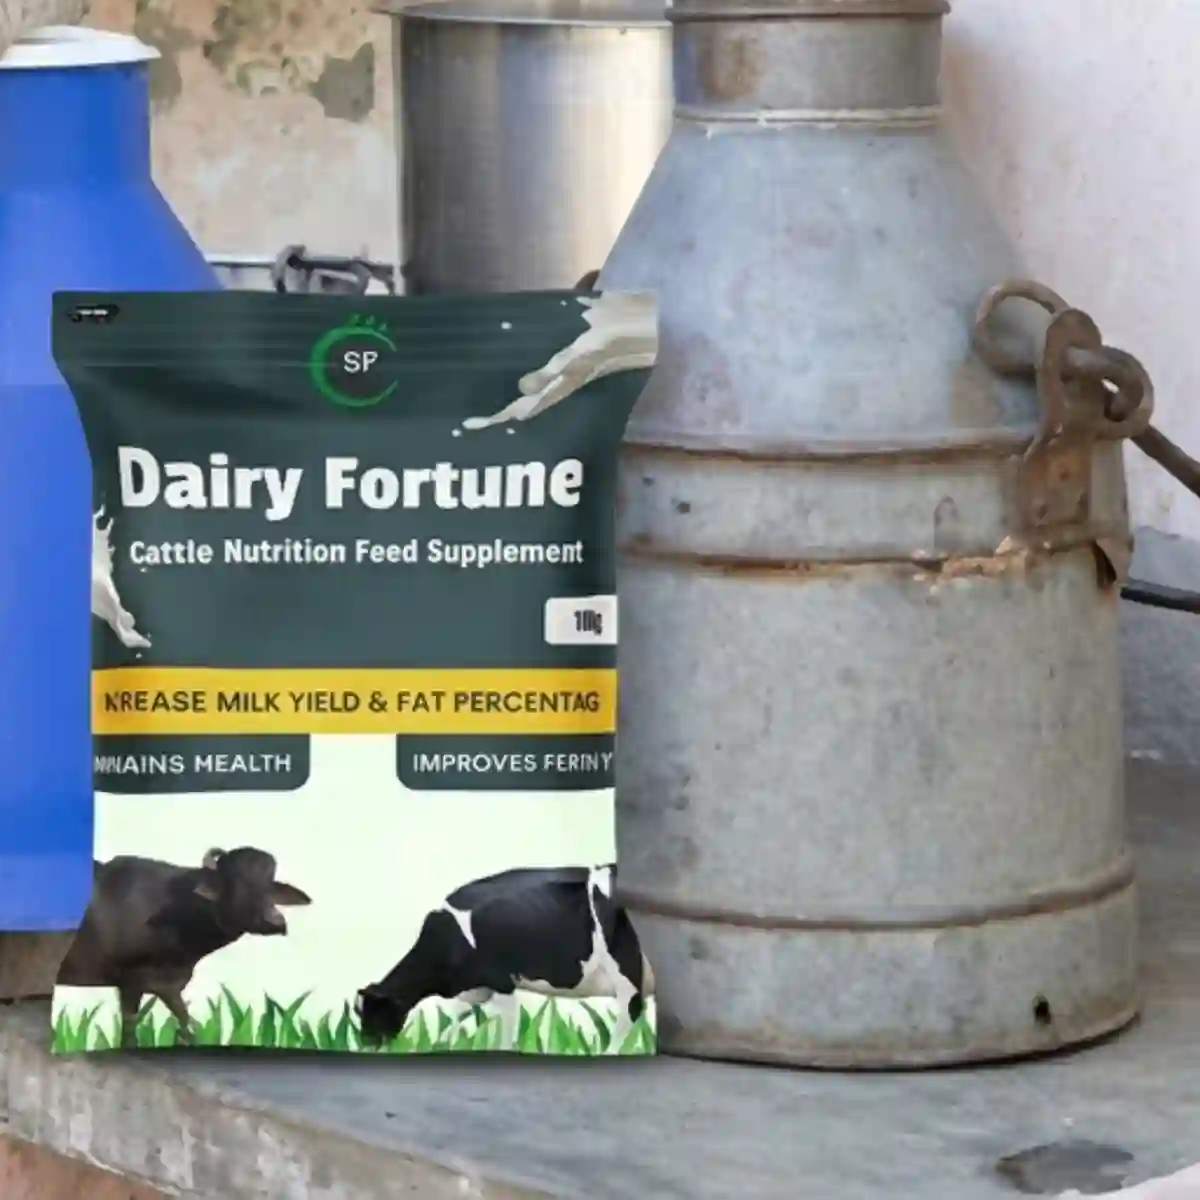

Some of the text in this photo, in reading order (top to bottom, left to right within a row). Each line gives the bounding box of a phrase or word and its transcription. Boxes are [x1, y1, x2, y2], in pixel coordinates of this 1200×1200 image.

[343, 350, 378, 373] SP
[118, 446, 583, 522] Dairy Fortune
[129, 537, 583, 569] Cattle Nutrition Feed Supplement
[217, 690, 280, 713] MILK
[289, 690, 361, 713] YIELD
[368, 690, 388, 713] &
[397, 690, 446, 713] FAT
[454, 690, 601, 713] PERCENTAG
[412, 753, 538, 773] IMPROVES
